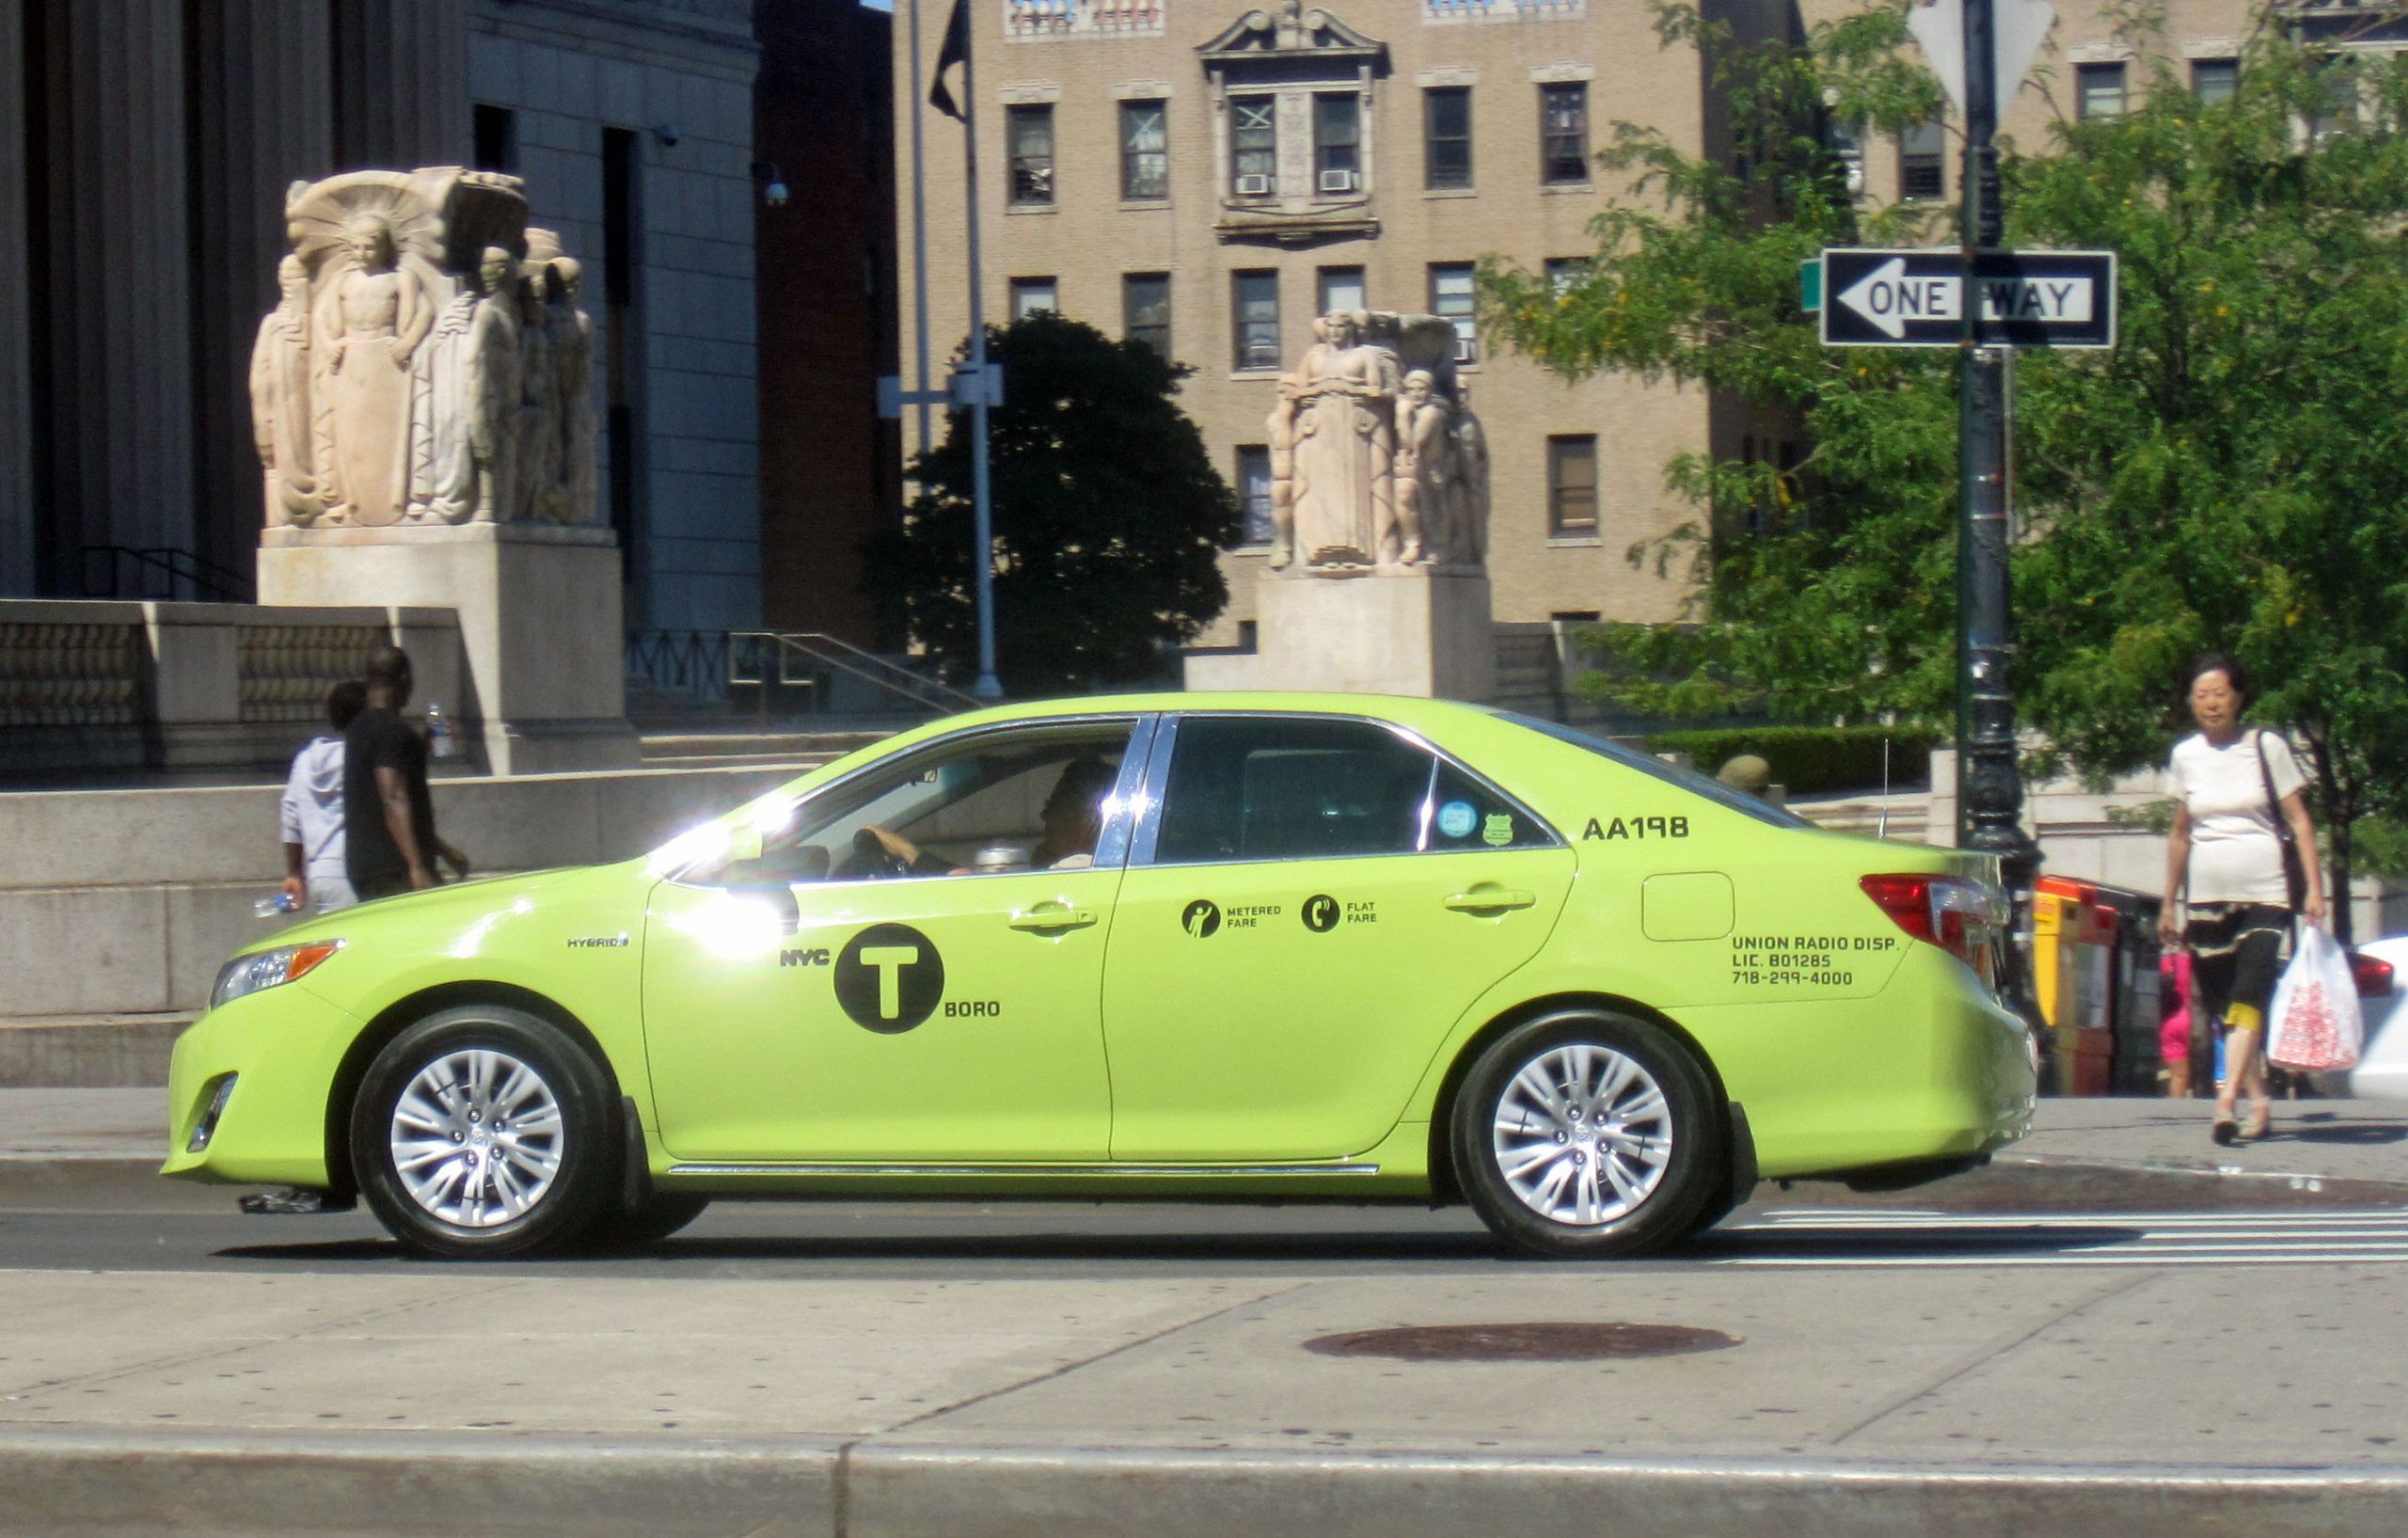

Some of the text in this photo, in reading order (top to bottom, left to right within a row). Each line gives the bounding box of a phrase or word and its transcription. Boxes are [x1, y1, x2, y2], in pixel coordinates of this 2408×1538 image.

[1869, 281, 2073, 317] ONE WAY
[1582, 816, 1689, 841] AA198
[1227, 906, 1282, 917] METERED
[1347, 902, 1375, 912] FLAT
[1227, 918, 1258, 928] FARE
[1347, 913, 1377, 924] FARE
[567, 938, 618, 948] HYBRID
[1733, 937, 1901, 951] UNION RADIO DISP.
[1733, 954, 1765, 967] LIC.
[780, 945, 1001, 1020] NYC T BORO
[1732, 972, 1853, 985] 718-299-4000
